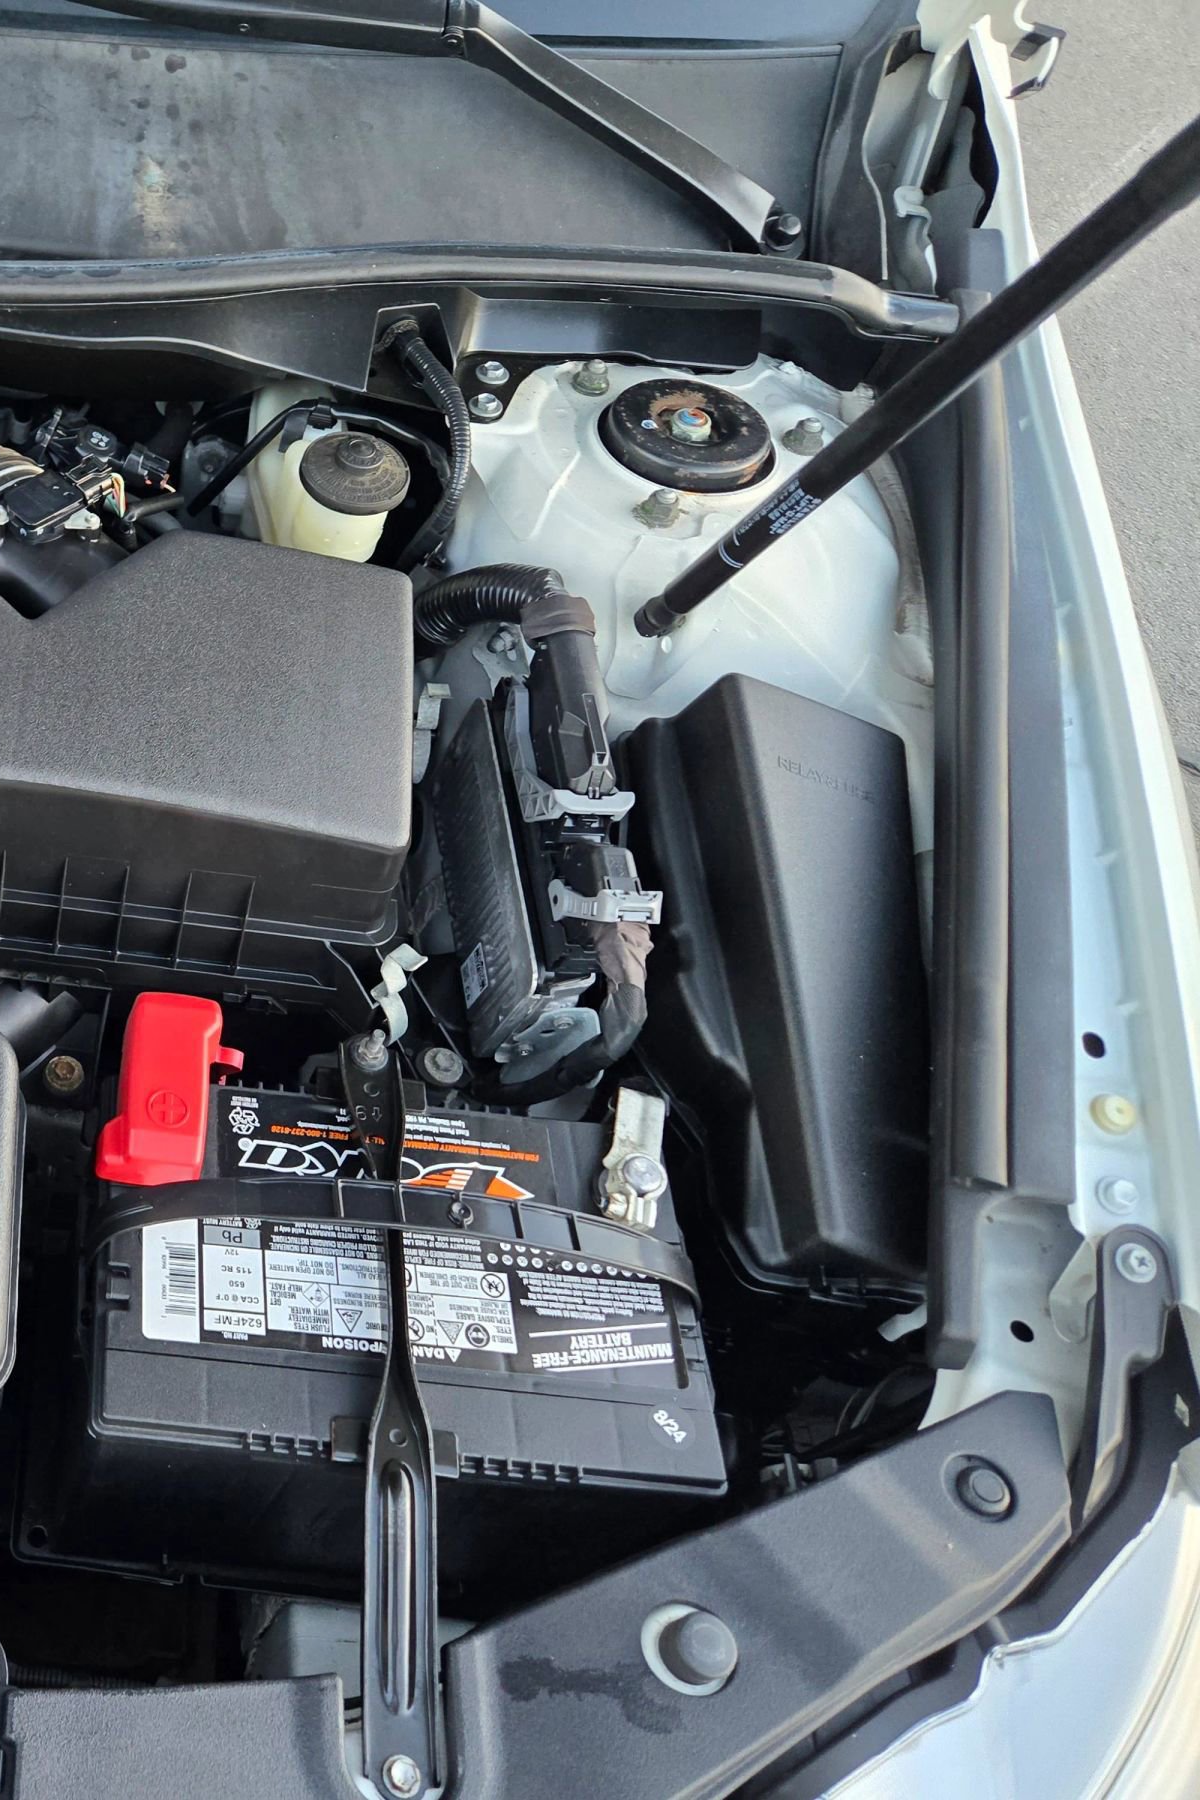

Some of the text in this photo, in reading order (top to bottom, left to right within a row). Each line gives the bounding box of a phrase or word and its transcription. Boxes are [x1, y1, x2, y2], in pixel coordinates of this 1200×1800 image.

[328, 1131, 349, 1141] FREE
[403, 1140, 439, 1151] INFORMAT
[279, 1225, 291, 1233] only
[291, 1227, 305, 1235] valid
[305, 1228, 336, 1239] WARRANTY
[221, 1229, 243, 1244] Pb
[337, 1231, 360, 1240] LIMITED
[309, 1238, 337, 1248] CHARGING
[336, 1241, 357, 1250] PROPER
[358, 1243, 377, 1252] OLLOW
[414, 1239, 428, 1248] THIS
[428, 1240, 434, 1248] IF
[435, 1241, 449, 1249] VOID
[449, 1242, 482, 1252] WARRANTY
[224, 1248, 240, 1256] 12V
[300, 1245, 309, 1253] OR
[308, 1245, 344, 1257] DISASSEMBLE
[344, 1249, 356, 1258] NOT
[418, 1249, 429, 1258] FOR
[356, 1250, 364, 1258] DO
[311, 1260, 323, 1269] NOT
[324, 1261, 334, 1270] DO
[436, 1259, 444, 1267] OF
[220, 1265, 252, 1275] 115 RC
[267, 1263, 335, 1277] DO NOT OPEN BATTERY.
[356, 1271, 367, 1279] ALL
[458, 1274, 478, 1283] REACH
[228, 1279, 245, 1288] 650
[268, 1282, 303, 1293] HELP FAST.
[429, 1279, 440, 1287] THE
[269, 1289, 297, 1300] MEDICAL
[240, 1295, 260, 1305] CCA
[269, 1298, 282, 1306] GET
[333, 1298, 363, 1307] BLINDNESS
[287, 1305, 329, 1316] WITH WATER.
[448, 1303, 479, 1313] BLINDNESS
[480, 1307, 497, 1315] CAUSE
[213, 1314, 263, 1329] 624FMF
[288, 1313, 330, 1325] IMMEDIATELY
[455, 1312, 510, 1325] EXPLOSIVE GASES
[293, 1322, 331, 1333] FLUSH EYES
[425, 1325, 435, 1333] NO
[221, 1331, 249, 1341] PART NO.
[491, 1335, 514, 1344] SHIELD
[569, 1331, 632, 1350] BATTERY
[531, 1342, 674, 1369] MAINTENANCE-FREE
[652, 1409, 687, 1444] 8/24
